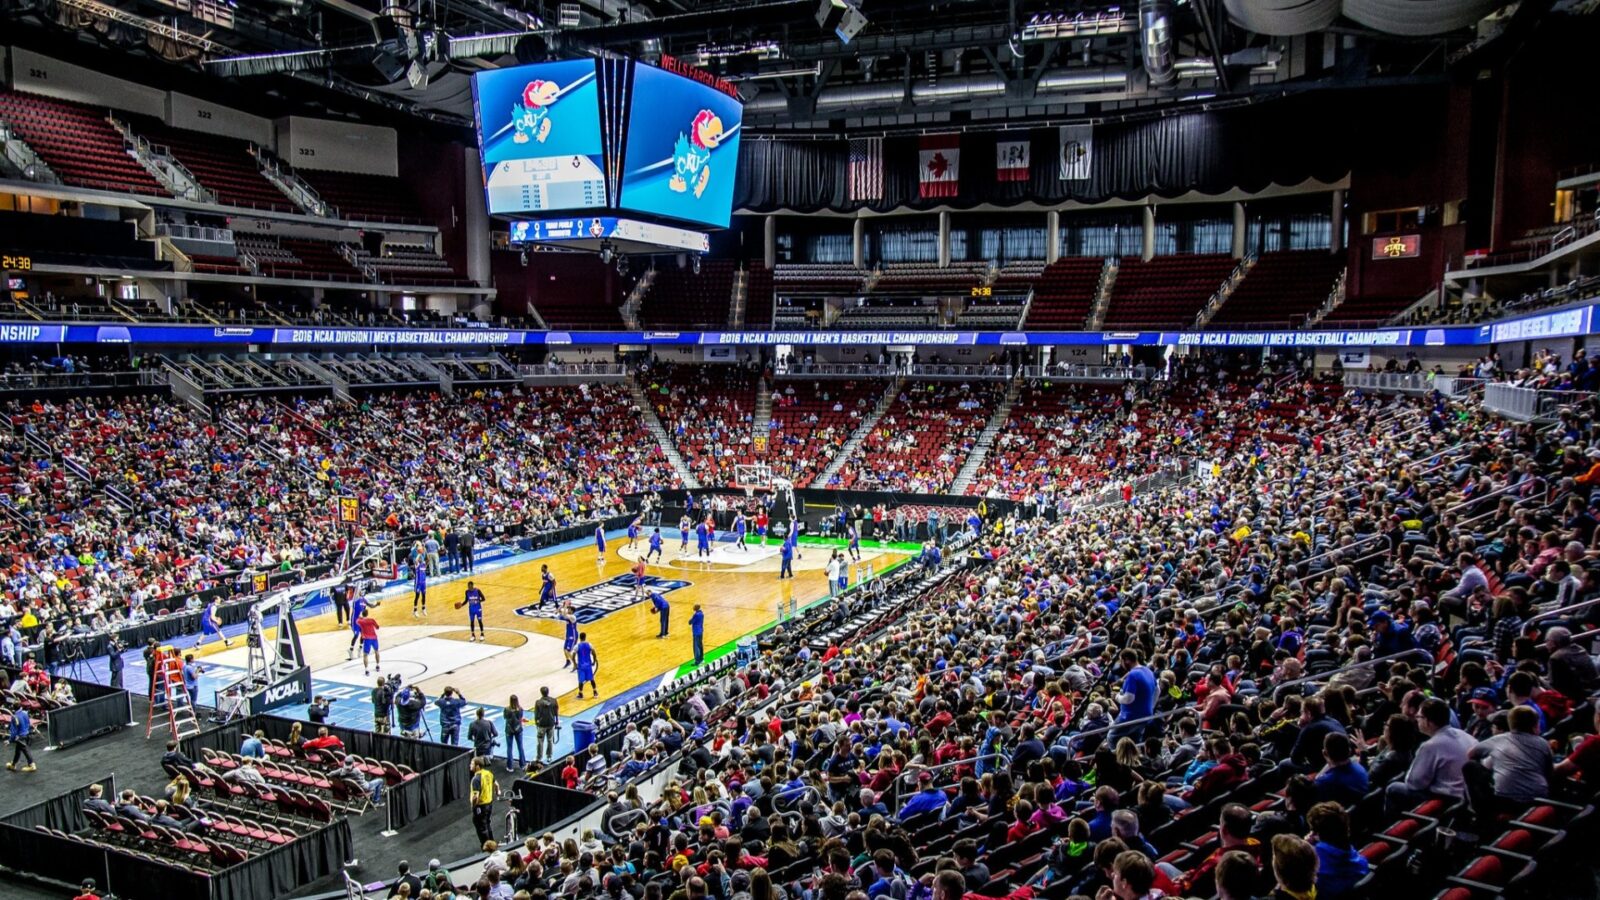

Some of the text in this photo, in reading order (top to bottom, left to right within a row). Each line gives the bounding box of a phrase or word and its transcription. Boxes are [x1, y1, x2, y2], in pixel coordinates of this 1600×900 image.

[30, 68, 47, 79] 321
[661, 53, 738, 97] WELLS FARGO ARENA
[299, 148, 315, 156] 323
[3, 255, 31, 269] 24:38
[292, 330, 312, 342] 2016
[314, 330, 334, 342] NCAA
[335, 330, 368, 342] DIVISION
[373, 331, 395, 342] MEN'S
[398, 331, 443, 343] BASKETBALL
[445, 331, 508, 343] CHAMPIONSHIP
[719, 333, 741, 343] 2016
[742, 333, 765, 343] NCAA
[767, 333, 805, 343] DIVISION
[812, 333, 840, 343] MEN'S
[841, 333, 891, 343] BASKETBALL
[893, 333, 958, 343] CHAMPIONSHIP
[1178, 333, 1201, 344] 2016
[1202, 333, 1227, 344] NCAA
[1228, 333, 1264, 344] DIVISION
[1269, 333, 1294, 344] MEN'S
[1295, 332, 1344, 345] BASKETBALL
[265, 680, 299, 705] NCAA
